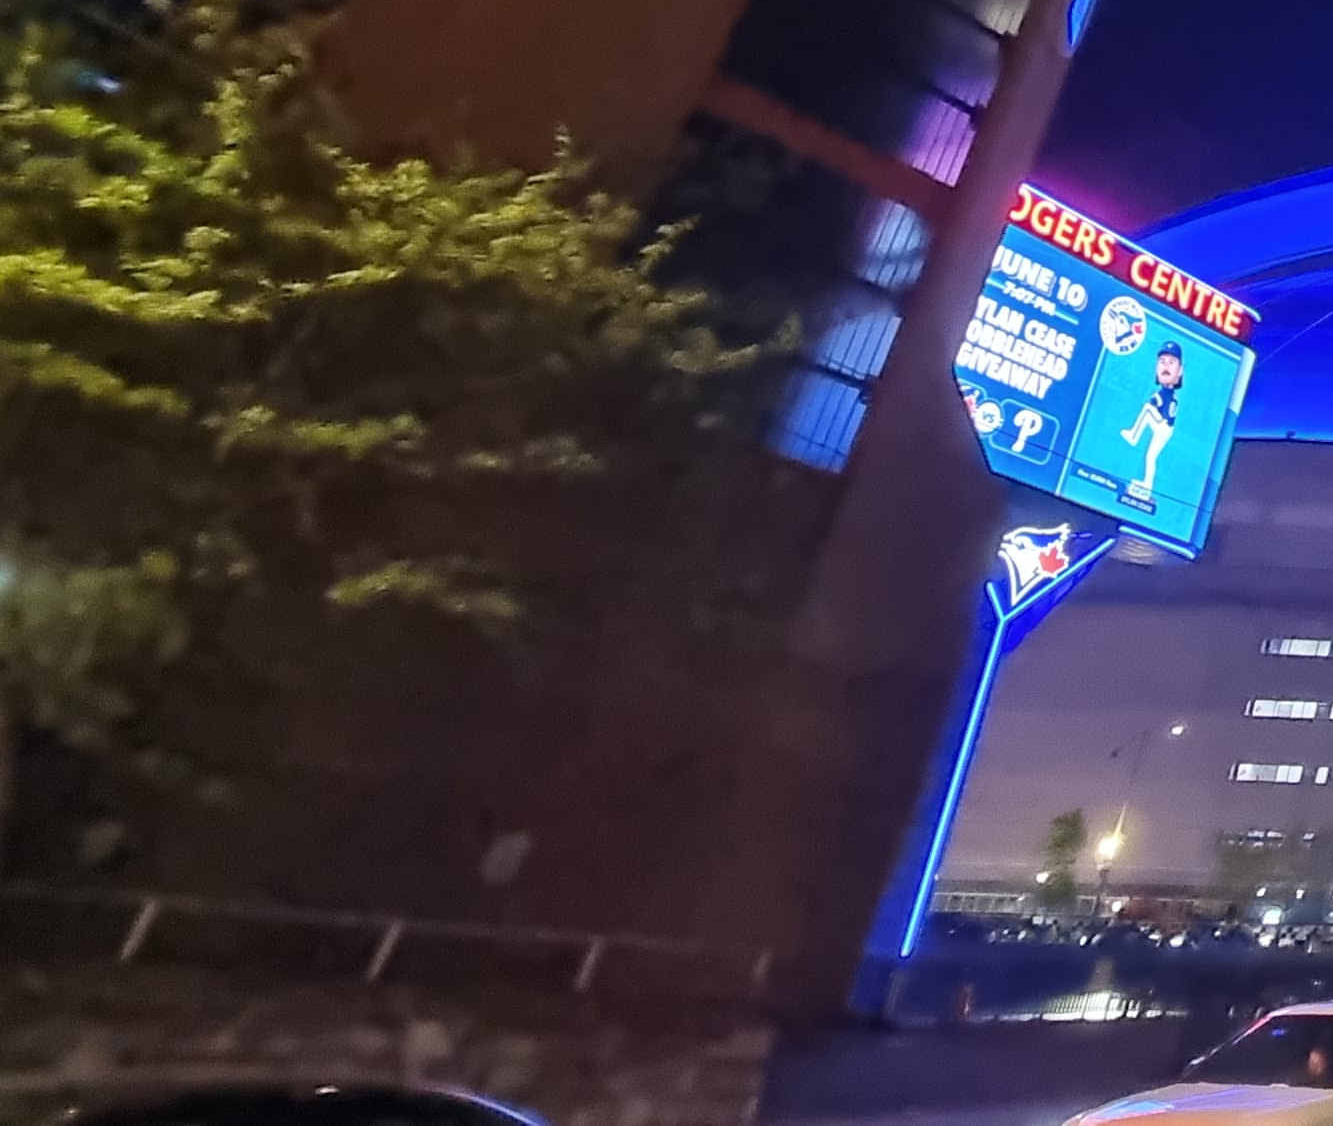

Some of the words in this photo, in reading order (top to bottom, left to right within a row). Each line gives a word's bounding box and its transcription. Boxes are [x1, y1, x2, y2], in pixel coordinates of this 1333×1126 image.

[991, 244, 1057, 295] JUNE
[1057, 276, 1087, 310] 10
[1009, 186, 1115, 266] OGERS
[1130, 254, 1244, 336] CENTRE
[965, 319, 1068, 382] OBBLEHEAD
[975, 294, 1025, 336] YLAN
[1024, 319, 1077, 360] CEASE
[955, 341, 1053, 400] GIVEAWAY
[981, 412, 996, 425] VS
